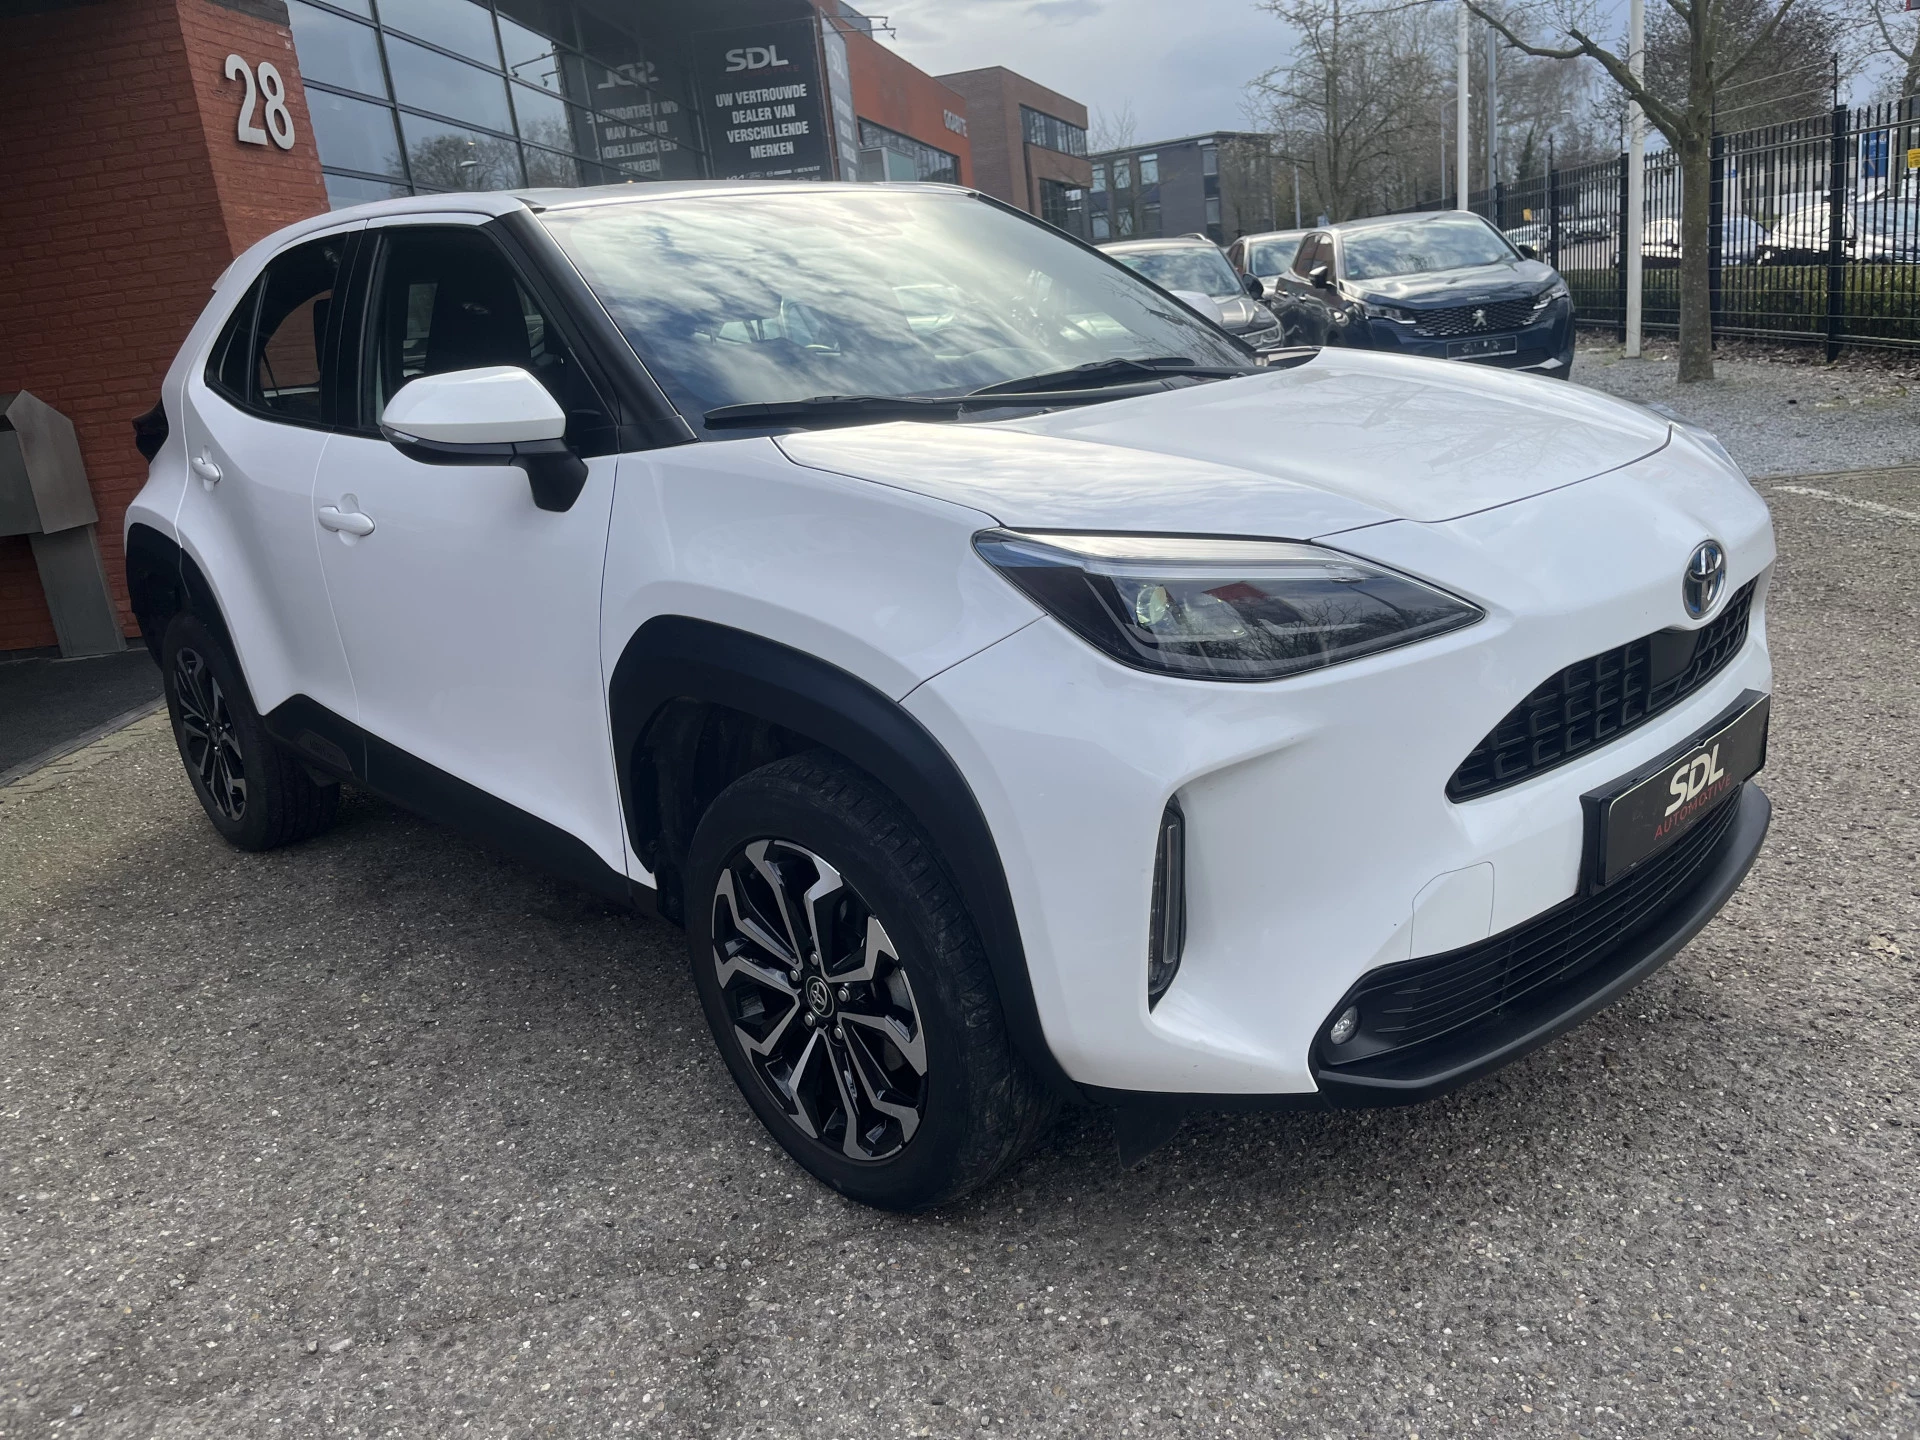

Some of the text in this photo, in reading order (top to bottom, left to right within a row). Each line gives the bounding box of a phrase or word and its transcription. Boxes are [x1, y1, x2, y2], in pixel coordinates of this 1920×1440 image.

[725, 45, 789, 72] SDL
[225, 53, 295, 150] 28
[715, 84, 807, 108] UW VERTROUWDE
[732, 104, 796, 124] DEALER VAN
[727, 121, 809, 143] VERSCHILLENDE
[750, 141, 794, 159] MERKEN
[1664, 743, 1724, 817] SDL
[1653, 773, 1732, 841] AUTOMOTIVE
